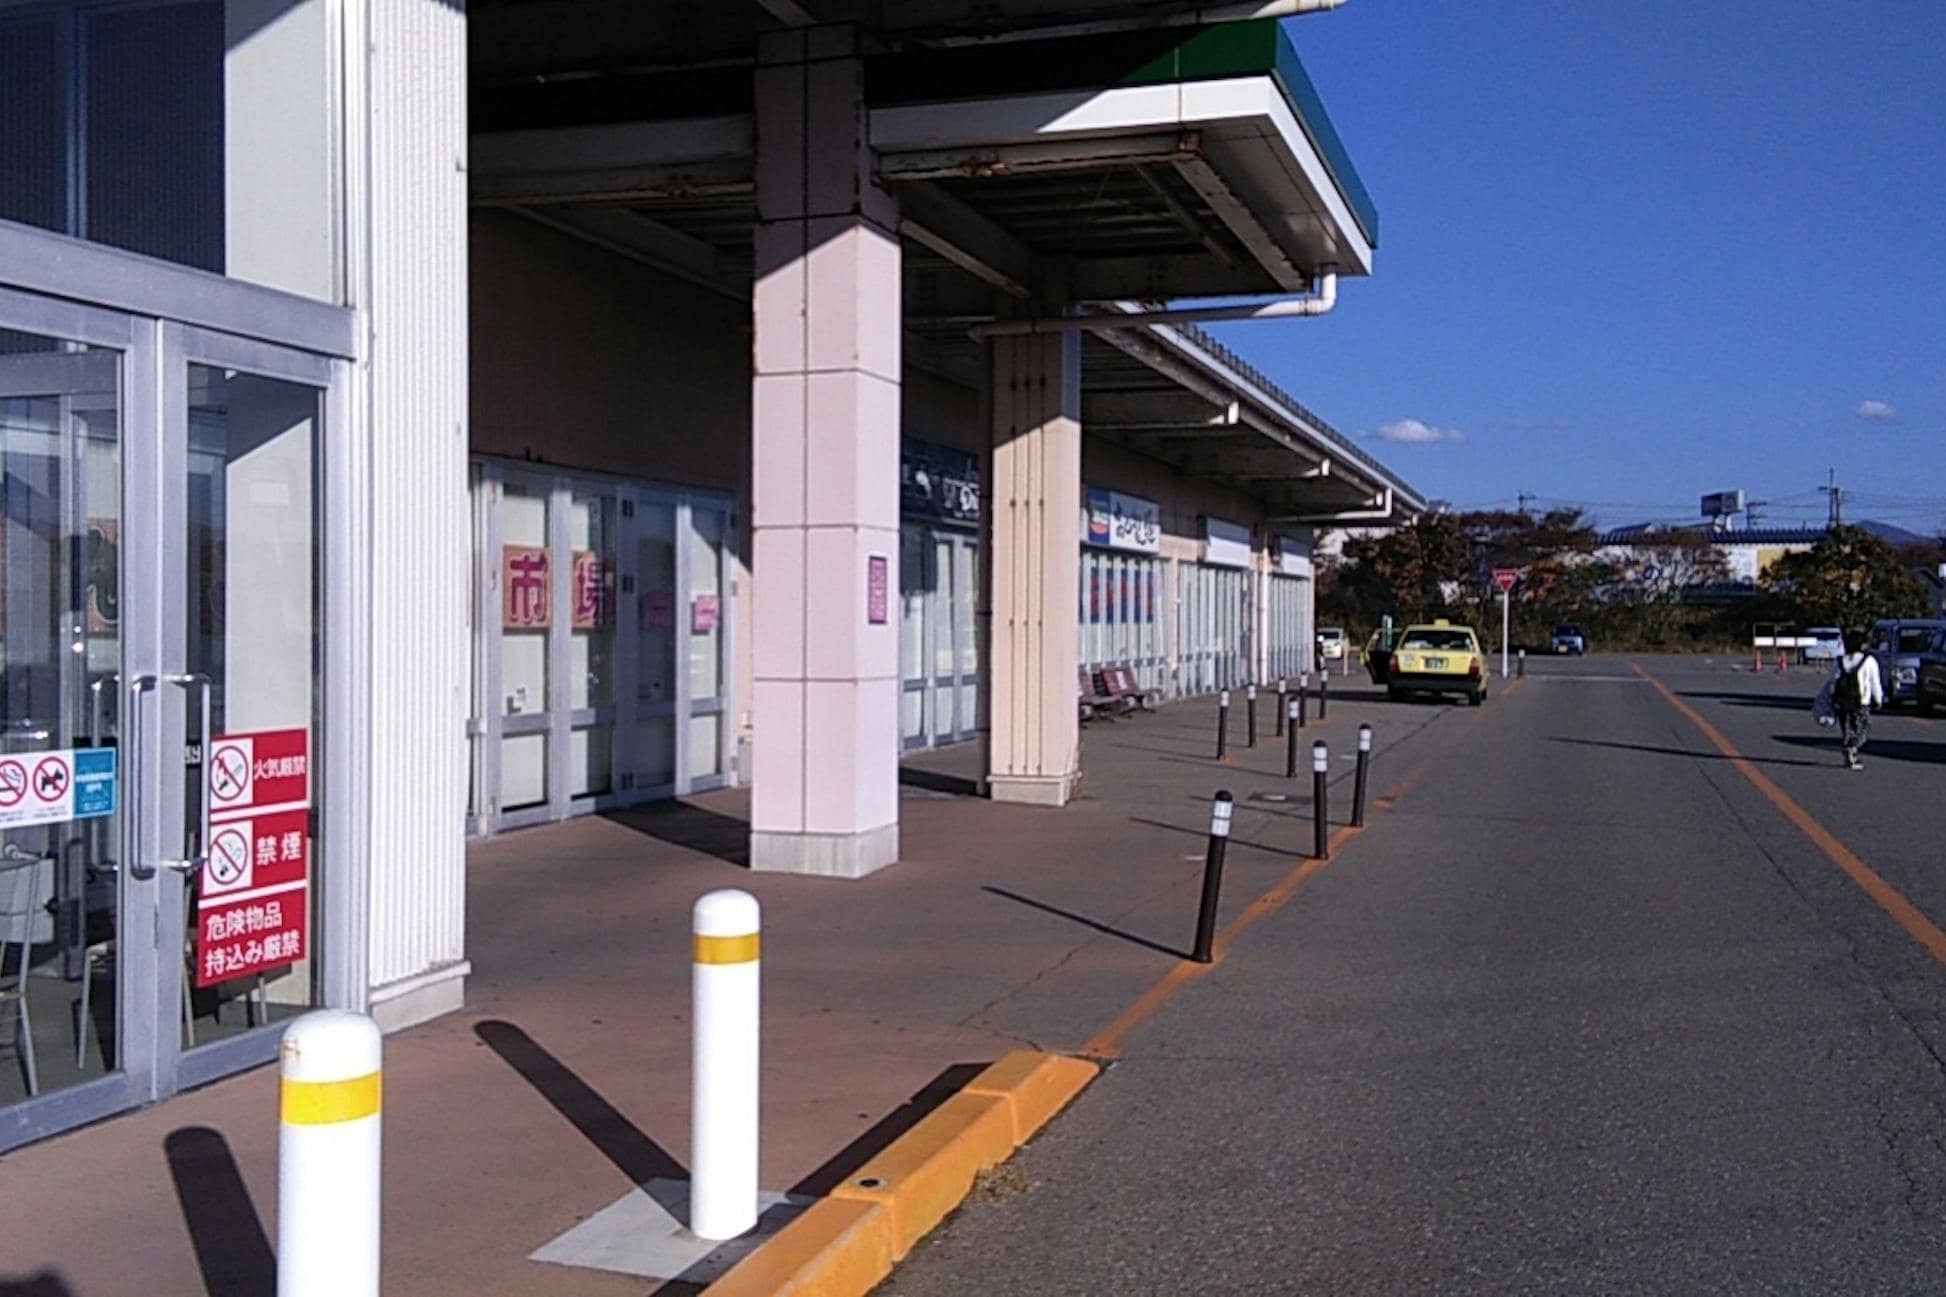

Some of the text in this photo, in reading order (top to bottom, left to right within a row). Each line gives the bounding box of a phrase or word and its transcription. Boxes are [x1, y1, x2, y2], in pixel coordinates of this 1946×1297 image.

[254, 756, 305, 779] 火気厳禁
[206, 901, 282, 942] 危険物品
[205, 929, 300, 977] 持込み厳禁
